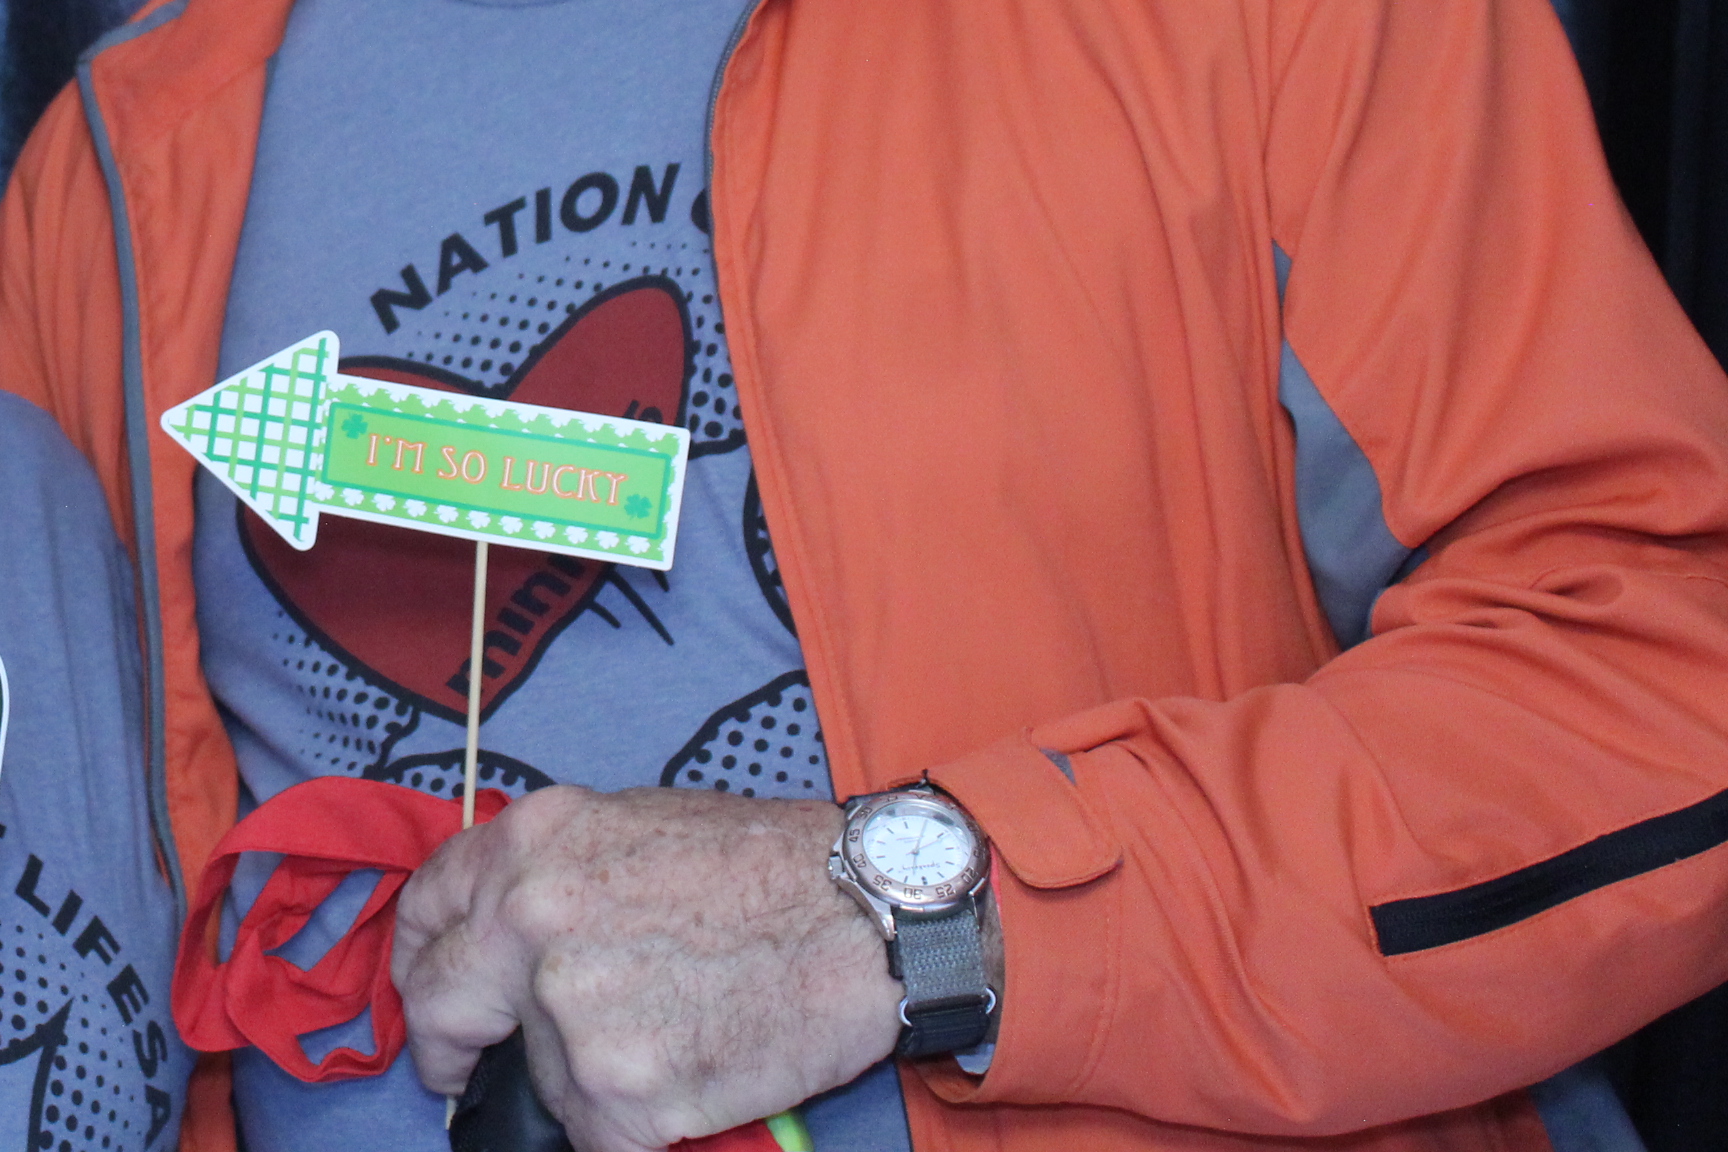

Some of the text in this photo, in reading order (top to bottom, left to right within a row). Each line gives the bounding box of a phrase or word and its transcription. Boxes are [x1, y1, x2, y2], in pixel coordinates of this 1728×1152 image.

[370, 163, 682, 335] NATION
[366, 433, 629, 505] I'M SO LUCKY
[873, 874, 892, 892] 35
[935, 883, 954, 898] 25
[903, 887, 923, 900] 30
